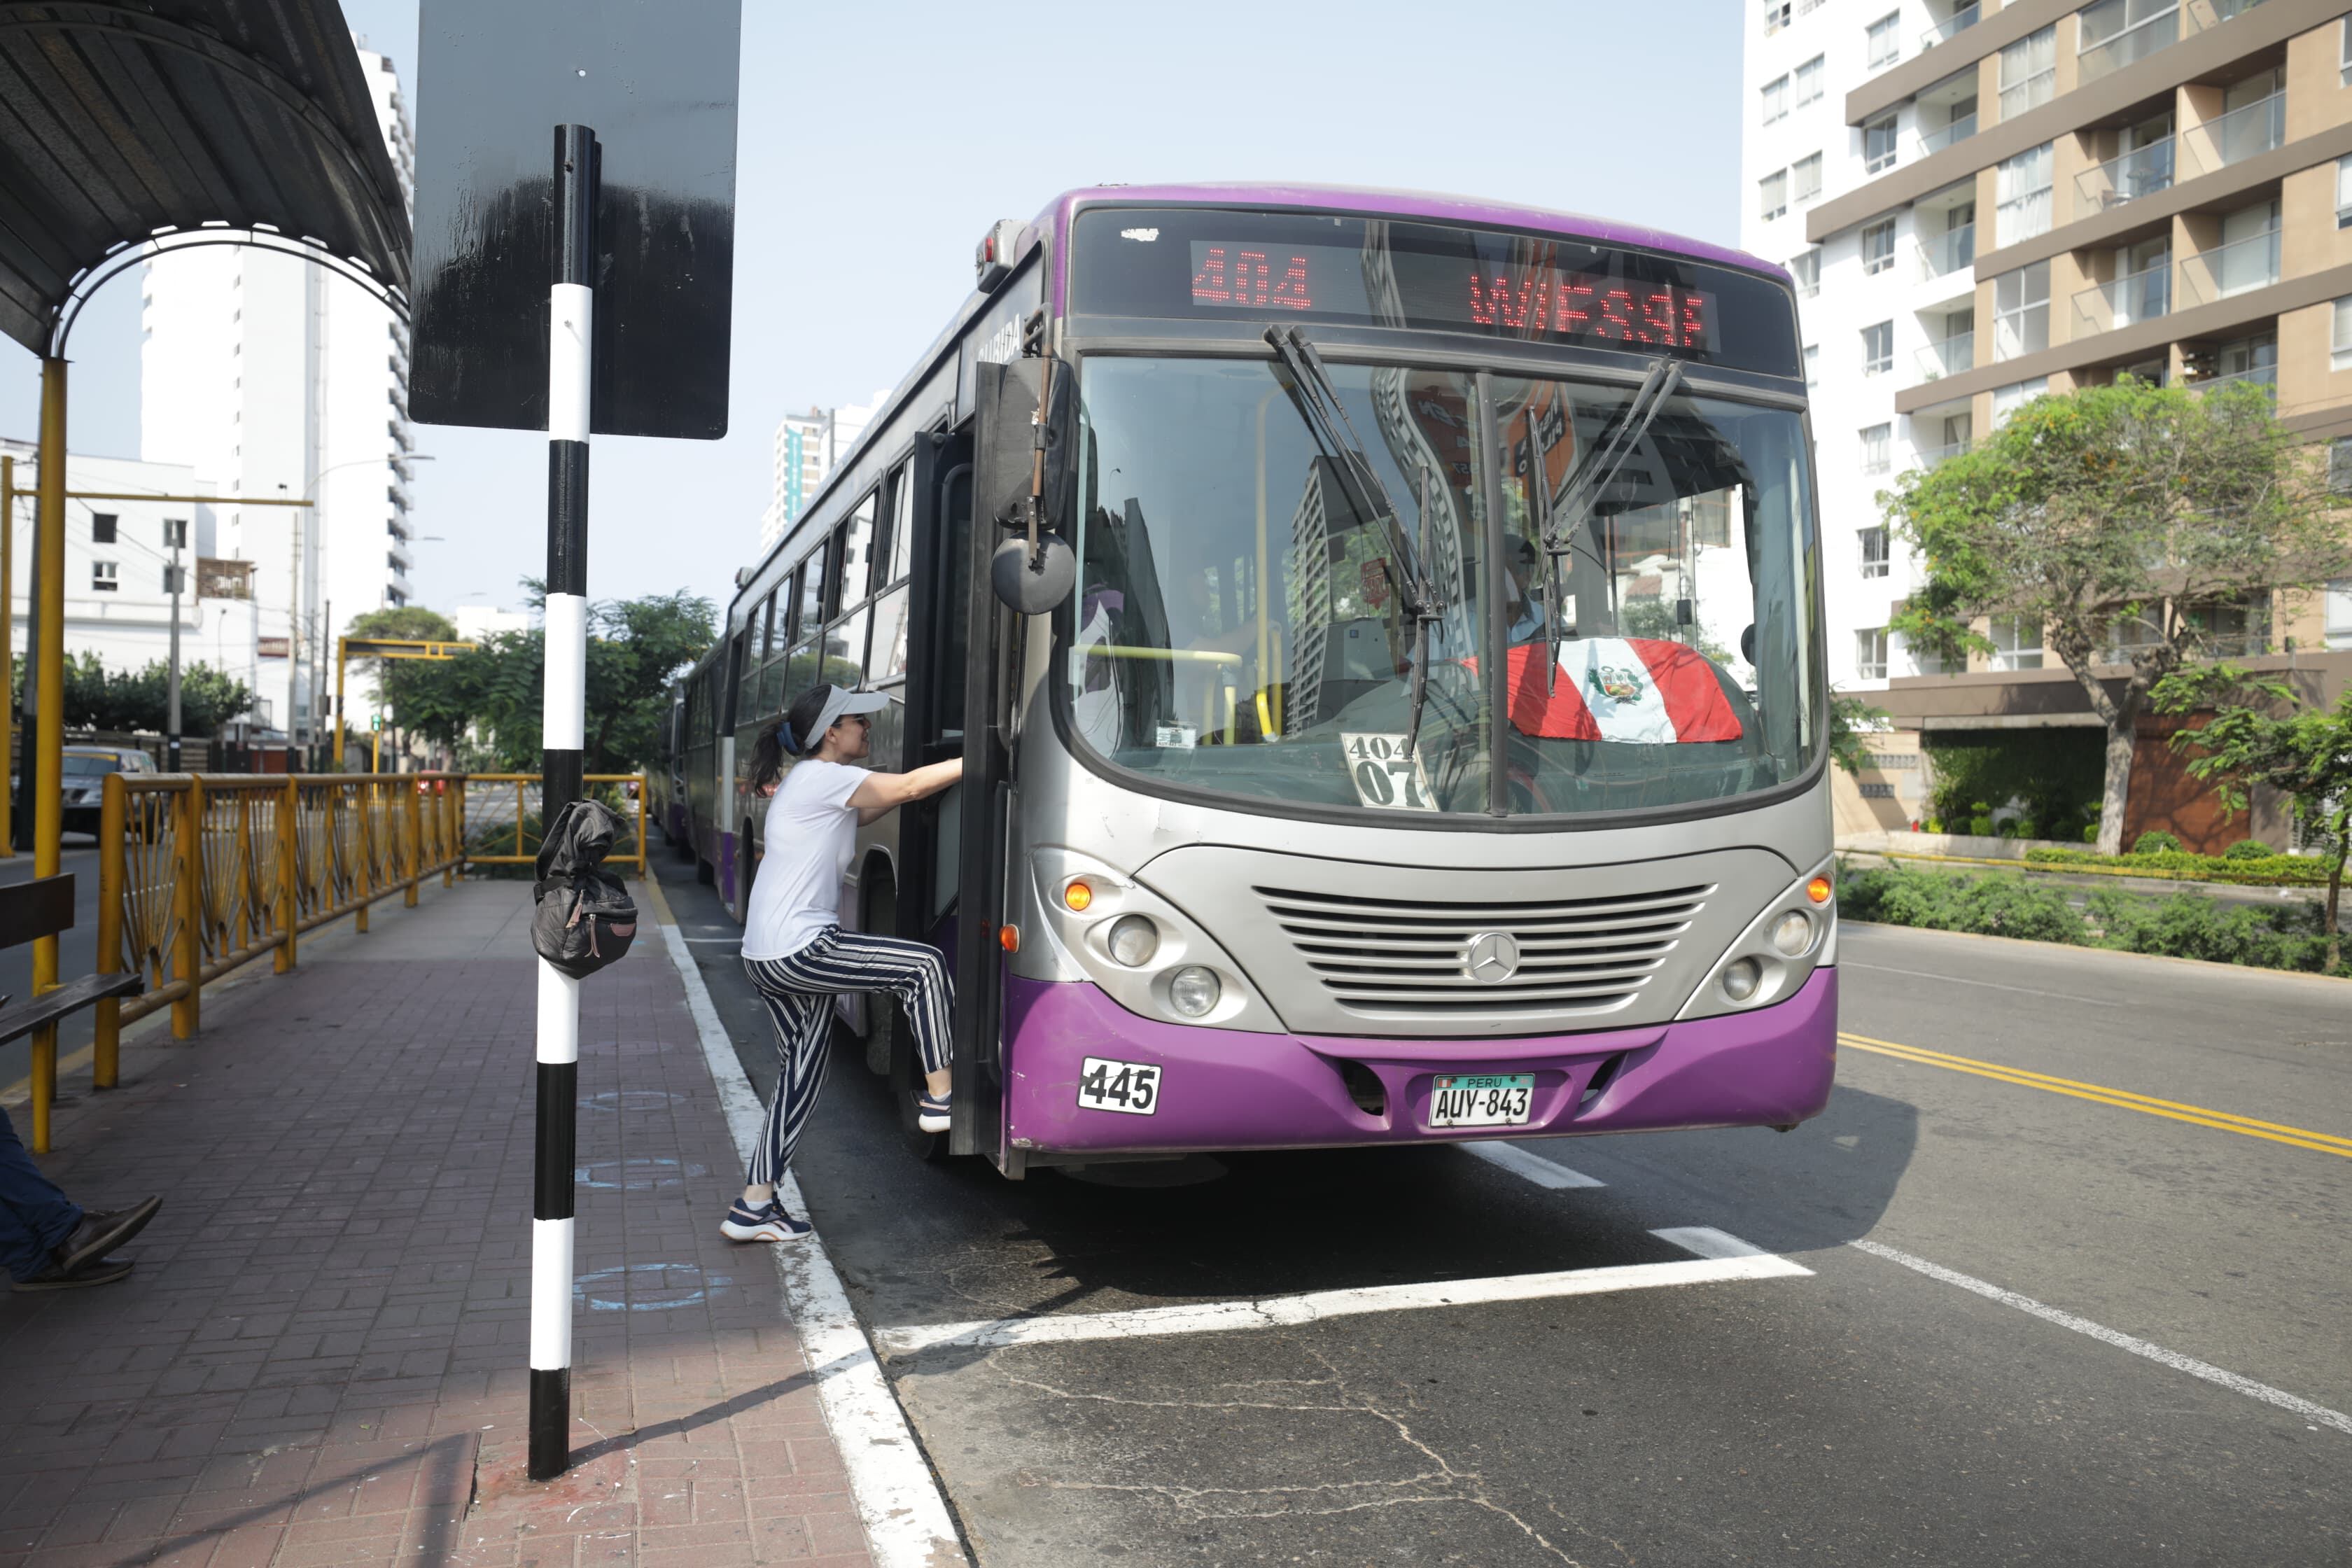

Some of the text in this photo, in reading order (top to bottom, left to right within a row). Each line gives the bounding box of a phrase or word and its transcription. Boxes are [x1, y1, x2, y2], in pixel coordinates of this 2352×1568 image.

[1192, 248, 1310, 309] 404
[1349, 736, 1413, 760] 404
[1357, 761, 1425, 808] 07
[1084, 1064, 1155, 1109] 445
[1467, 1078, 1502, 1088] PERU
[1436, 1088, 1527, 1119] AUY-843
